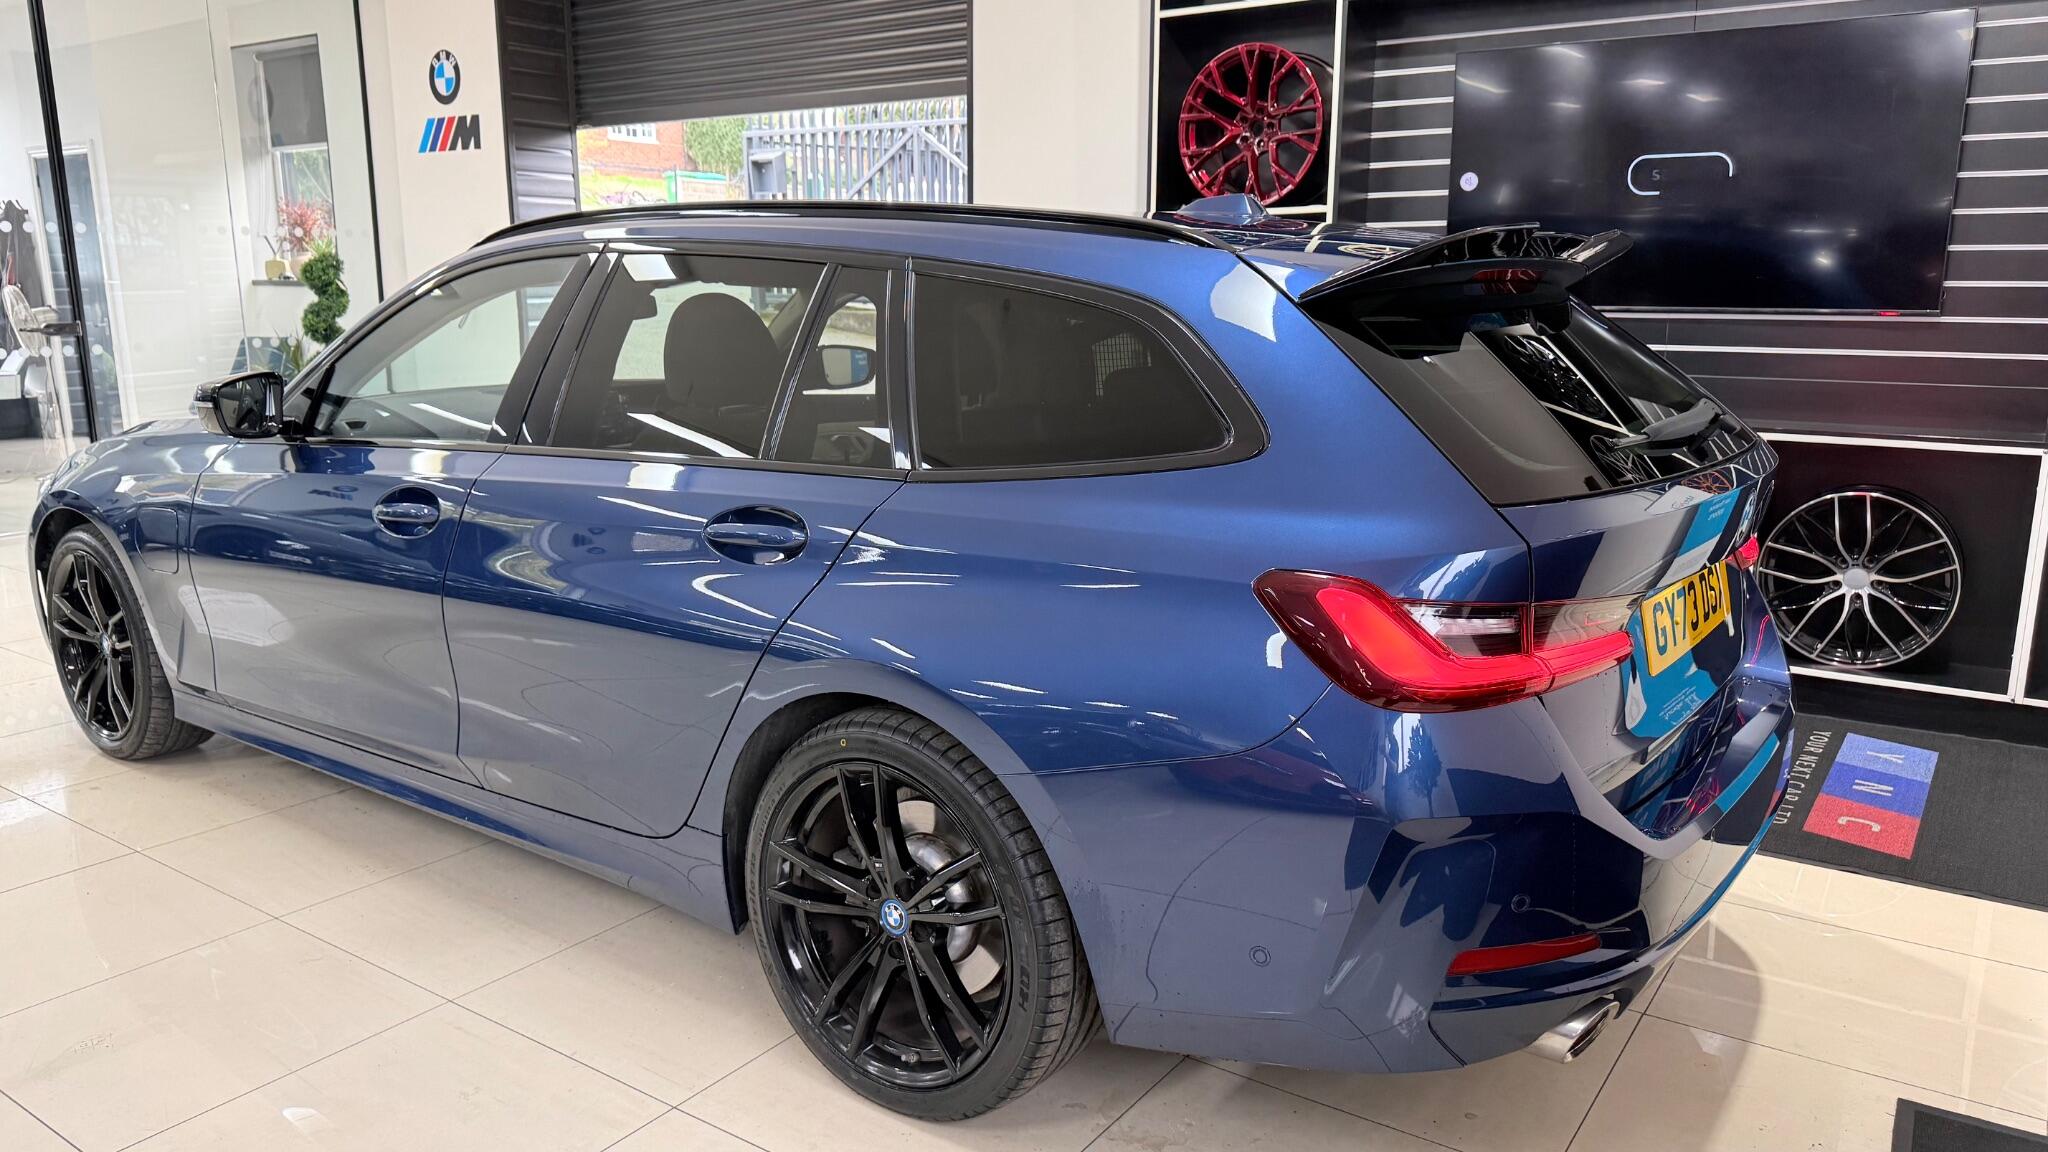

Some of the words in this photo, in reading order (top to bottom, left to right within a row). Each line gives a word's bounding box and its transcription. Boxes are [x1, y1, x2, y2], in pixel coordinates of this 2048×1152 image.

[431, 50, 457, 67] BMW
[1652, 580, 1700, 657] GY73
[1802, 730, 1833, 754] YOUR
[1789, 754, 1820, 780] NEXT
[1784, 780, 1806, 802] CAR
